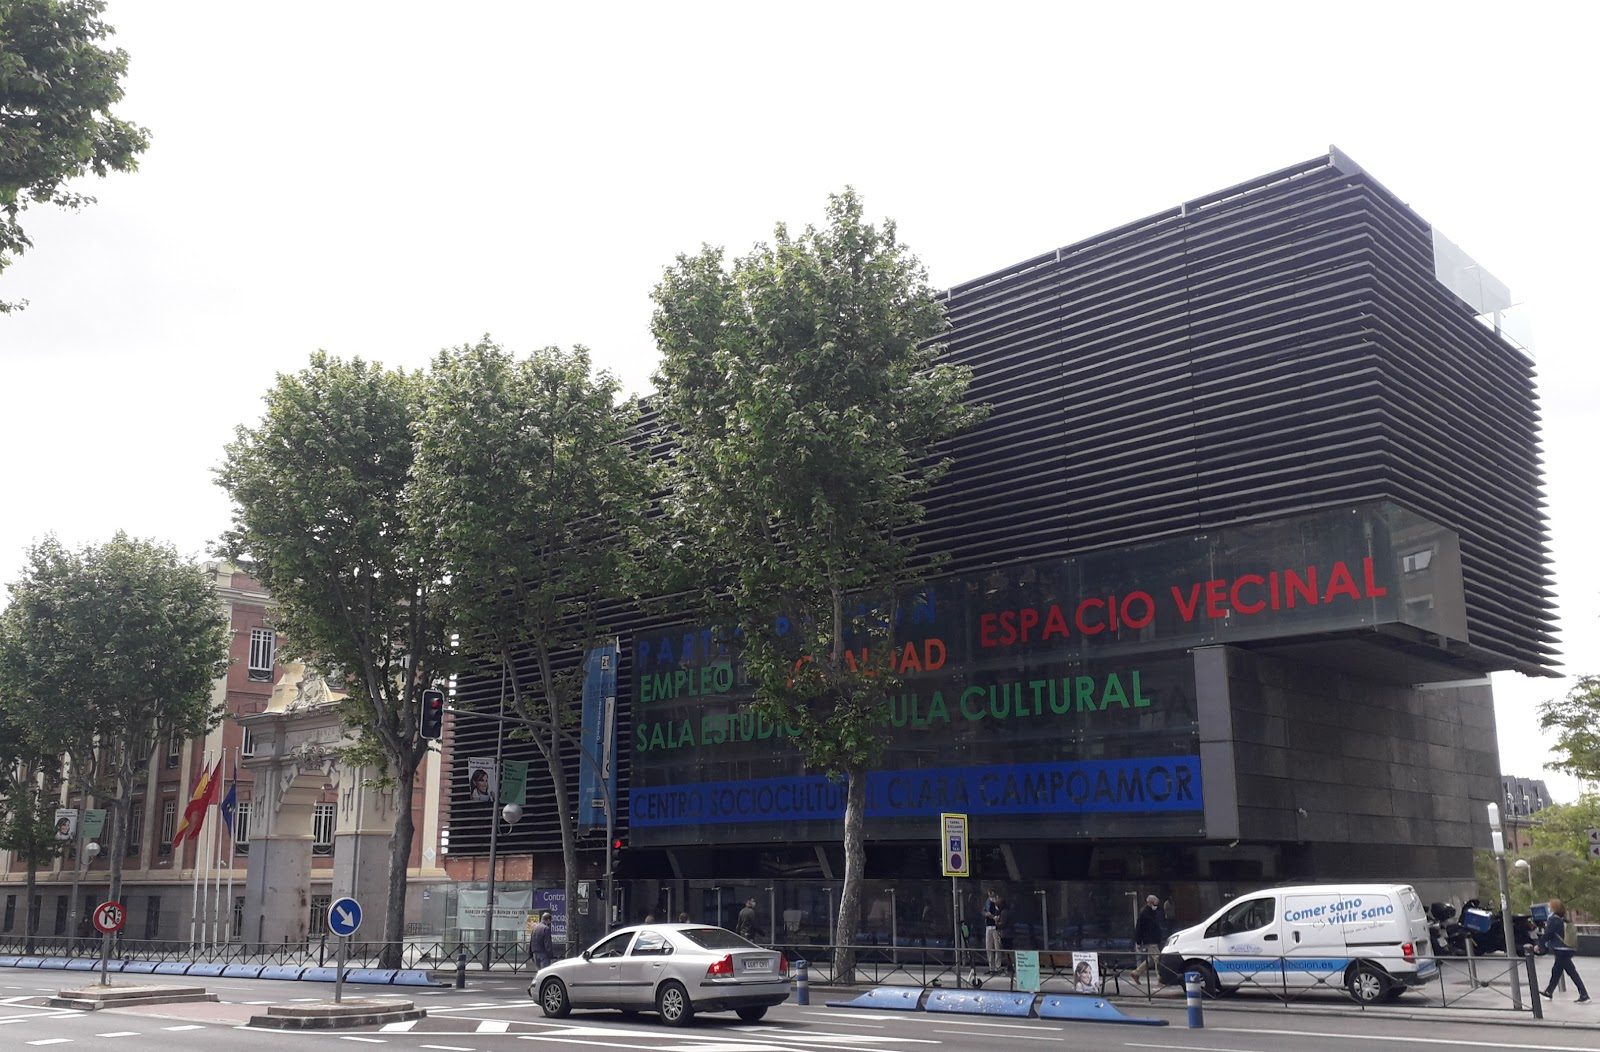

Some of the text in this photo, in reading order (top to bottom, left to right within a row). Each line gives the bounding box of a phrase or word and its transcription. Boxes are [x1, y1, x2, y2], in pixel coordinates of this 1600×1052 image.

[980, 556, 1387, 648] ESPACIO VECINAL
[640, 662, 734, 703] EMPLEO
[878, 671, 1151, 729] ULA CULTURAL
[635, 718, 695, 752] SALA
[701, 707, 806, 745] ESTUDIO
[634, 764, 1194, 820] CENTRO SOCIOCULTUL CLARA CAMPOAMOR
[543, 891, 566, 901] Contra
[549, 902, 558, 911] las
[1284, 897, 1363, 922] Comer sano
[1328, 911, 1359, 925] vivir
[1361, 903, 1394, 920] sano
